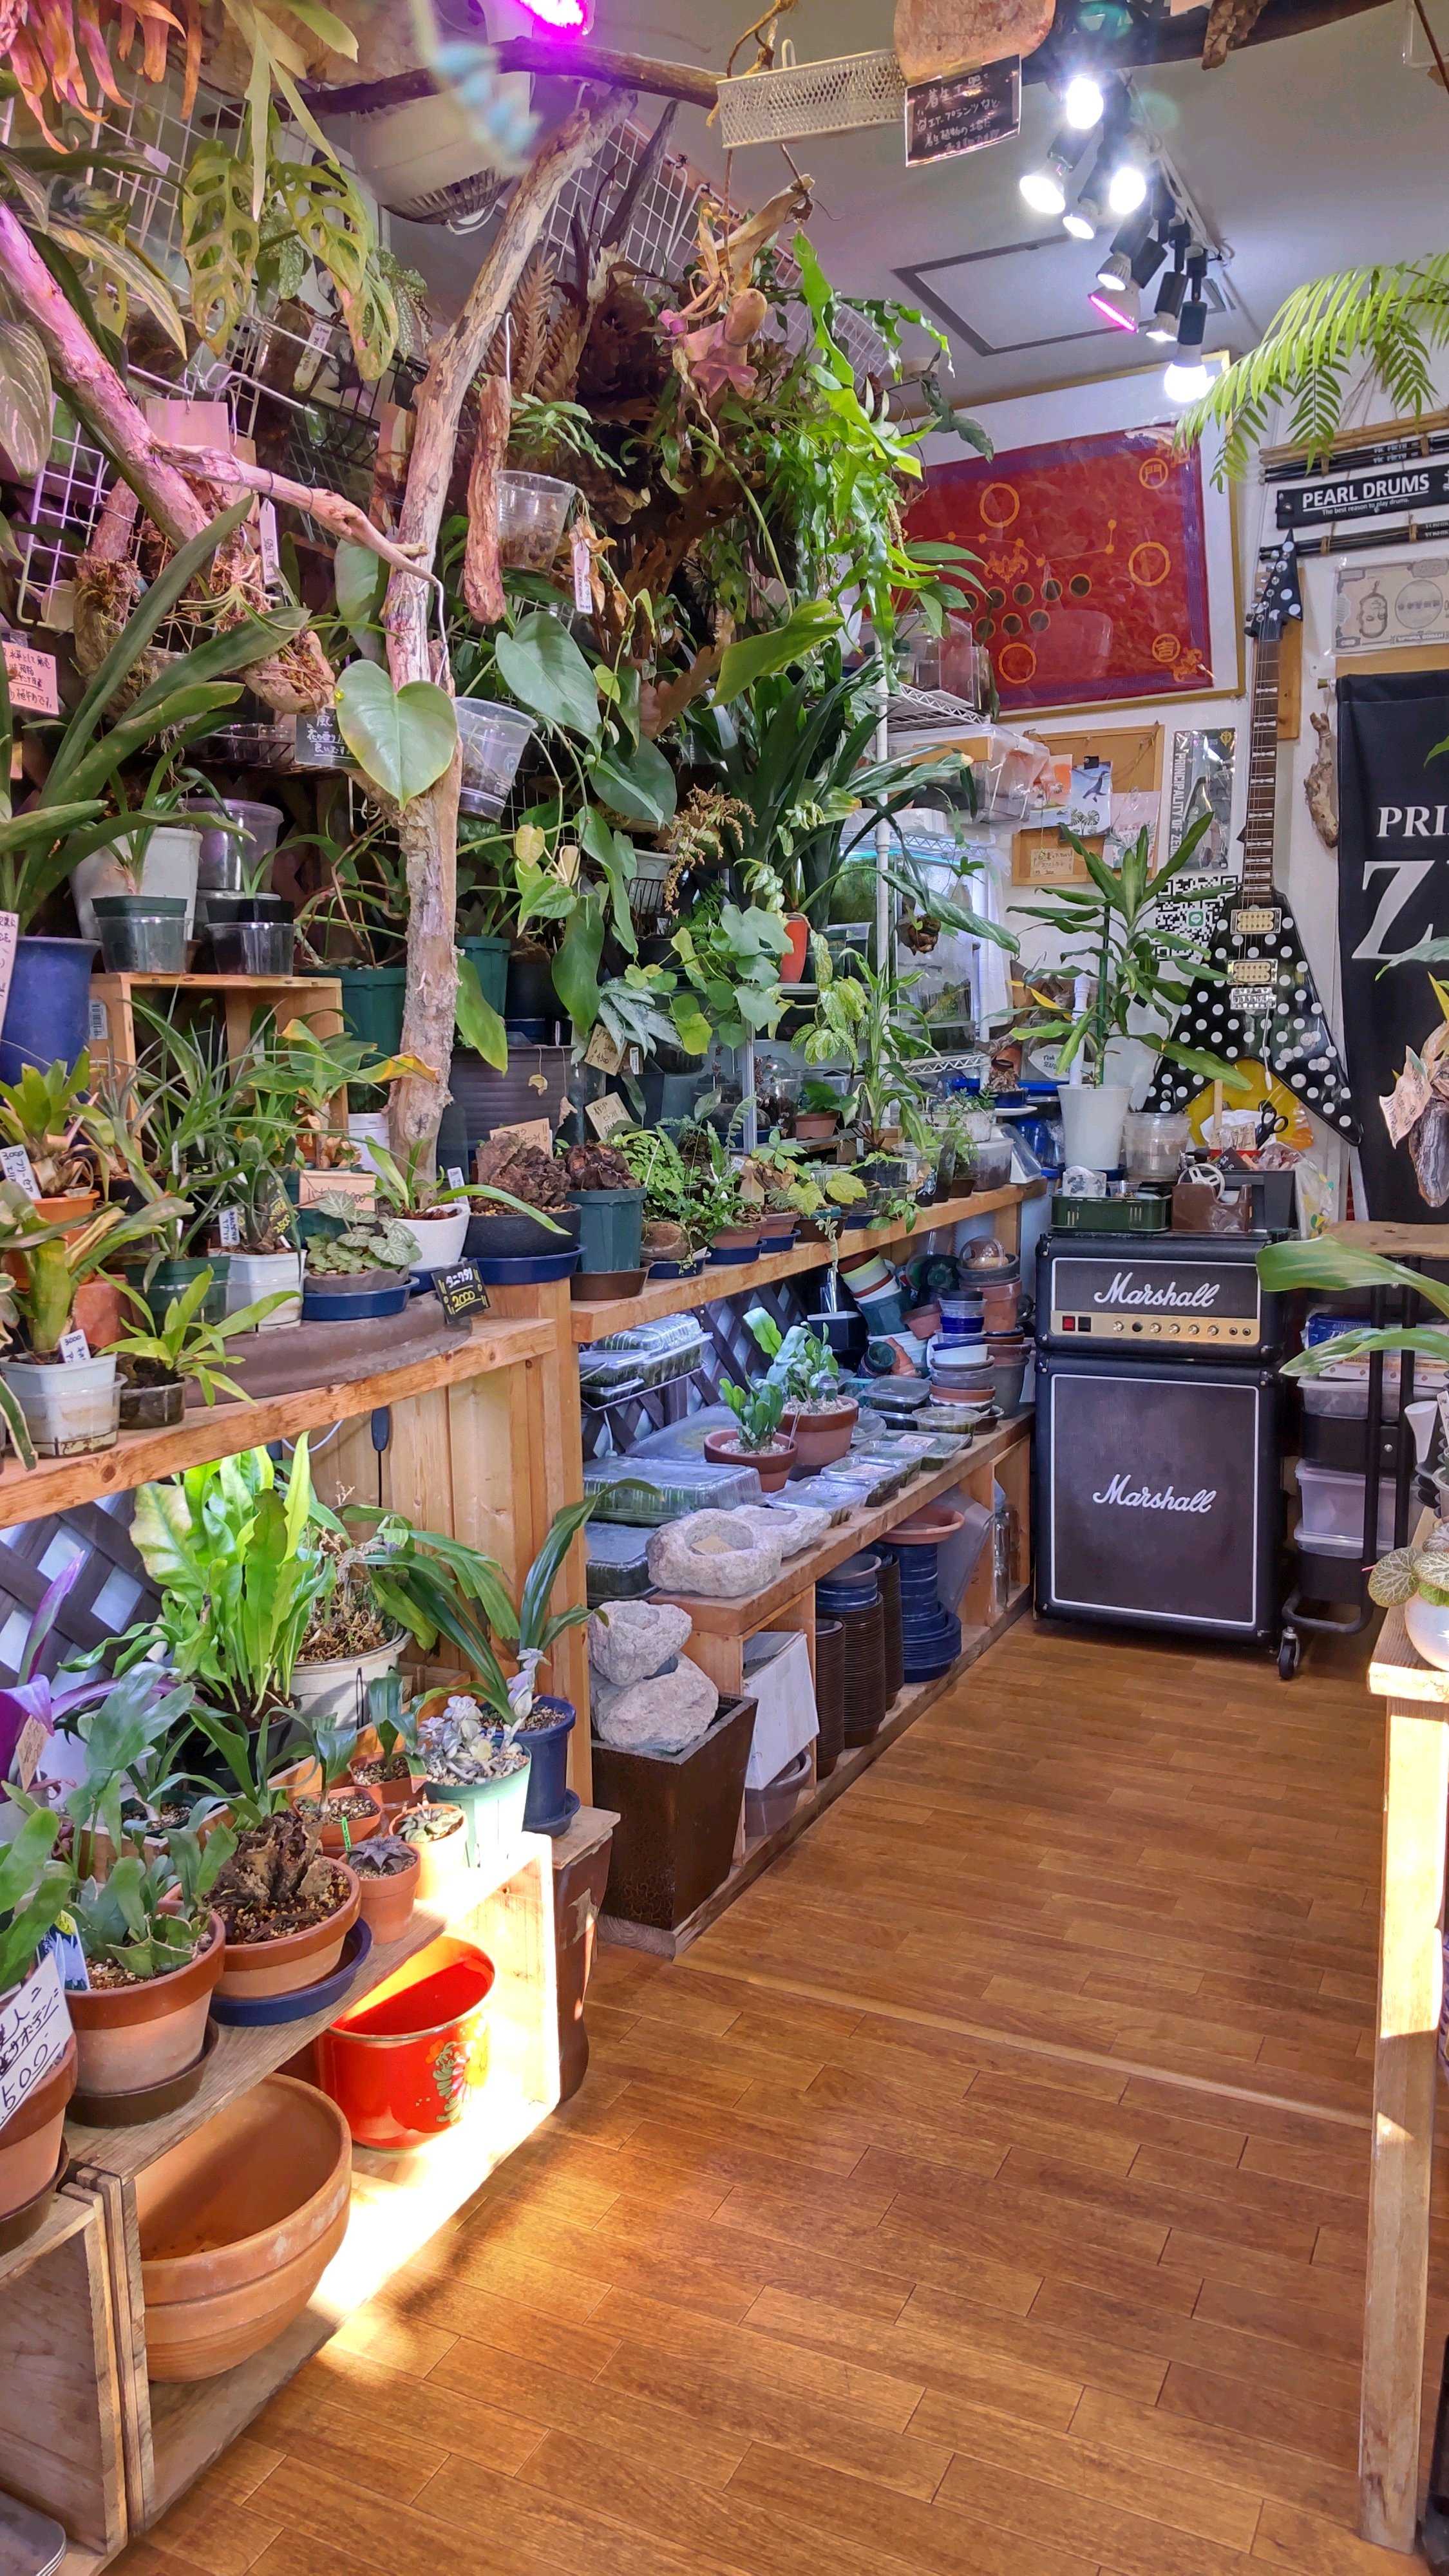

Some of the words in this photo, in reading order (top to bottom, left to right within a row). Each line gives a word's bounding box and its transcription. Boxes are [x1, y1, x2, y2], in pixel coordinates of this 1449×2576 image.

[1303, 485, 1358, 508] PEARL
[1363, 473, 1430, 500] DRUMS
[1377, 500, 1388, 509] play
[1171, 752, 1186, 821] PRINCIPALITY
[1171, 819, 1183, 835] OF
[1376, 804, 1449, 837] PRI
[452, 1291, 475, 1308] 2000
[1094, 1272, 1220, 1308] Marshall
[1092, 1473, 1217, 1513] Marshall
